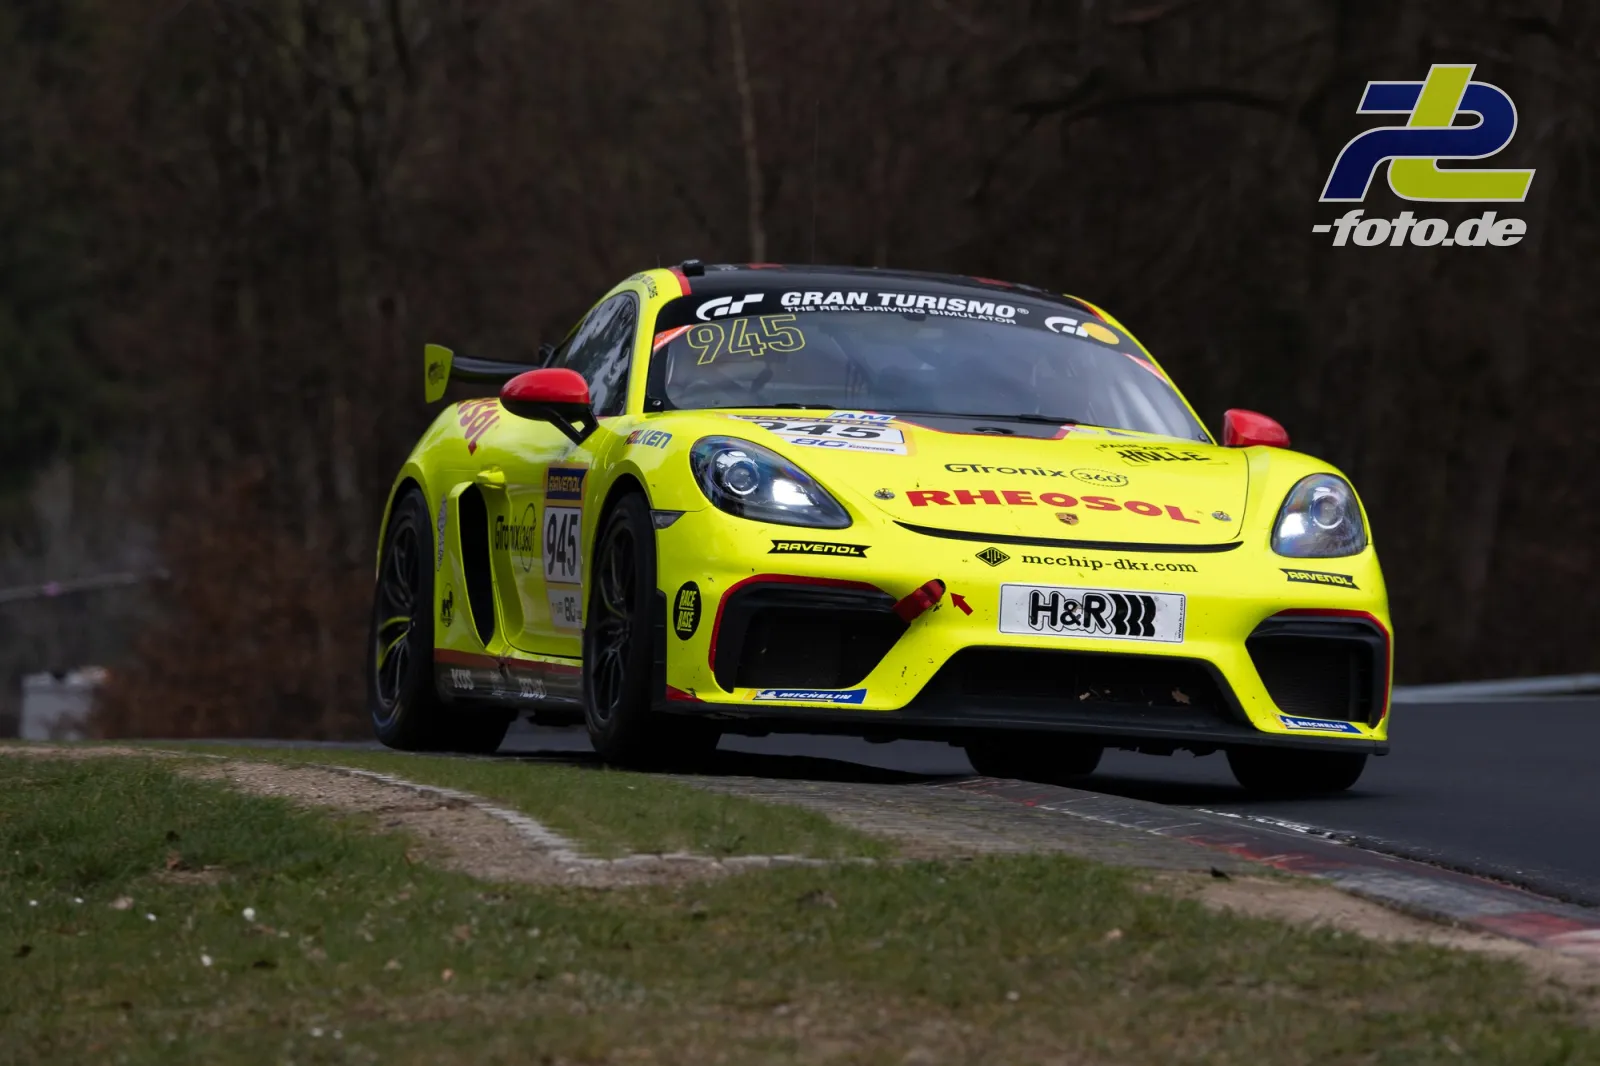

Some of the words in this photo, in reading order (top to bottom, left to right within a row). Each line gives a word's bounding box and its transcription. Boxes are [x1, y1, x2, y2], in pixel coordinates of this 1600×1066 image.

[780, 291, 869, 306] GRAN
[862, 305, 925, 315] DRIVING
[928, 309, 1017, 325] SIMULATOR
[686, 313, 806, 366] 945
[833, 413, 892, 421] AM
[944, 463, 1069, 479] GTronix
[904, 488, 1201, 525] RHEOSOL
[546, 512, 578, 577] 945
[776, 542, 860, 555] RAVENOL
[1021, 554, 1199, 573] mcchip-dkr.com
[1287, 570, 1353, 586] RAVENOL
[1029, 591, 1112, 633] H&R
[778, 691, 853, 700] MICHELIN
[1298, 720, 1348, 730] MICHELIN
